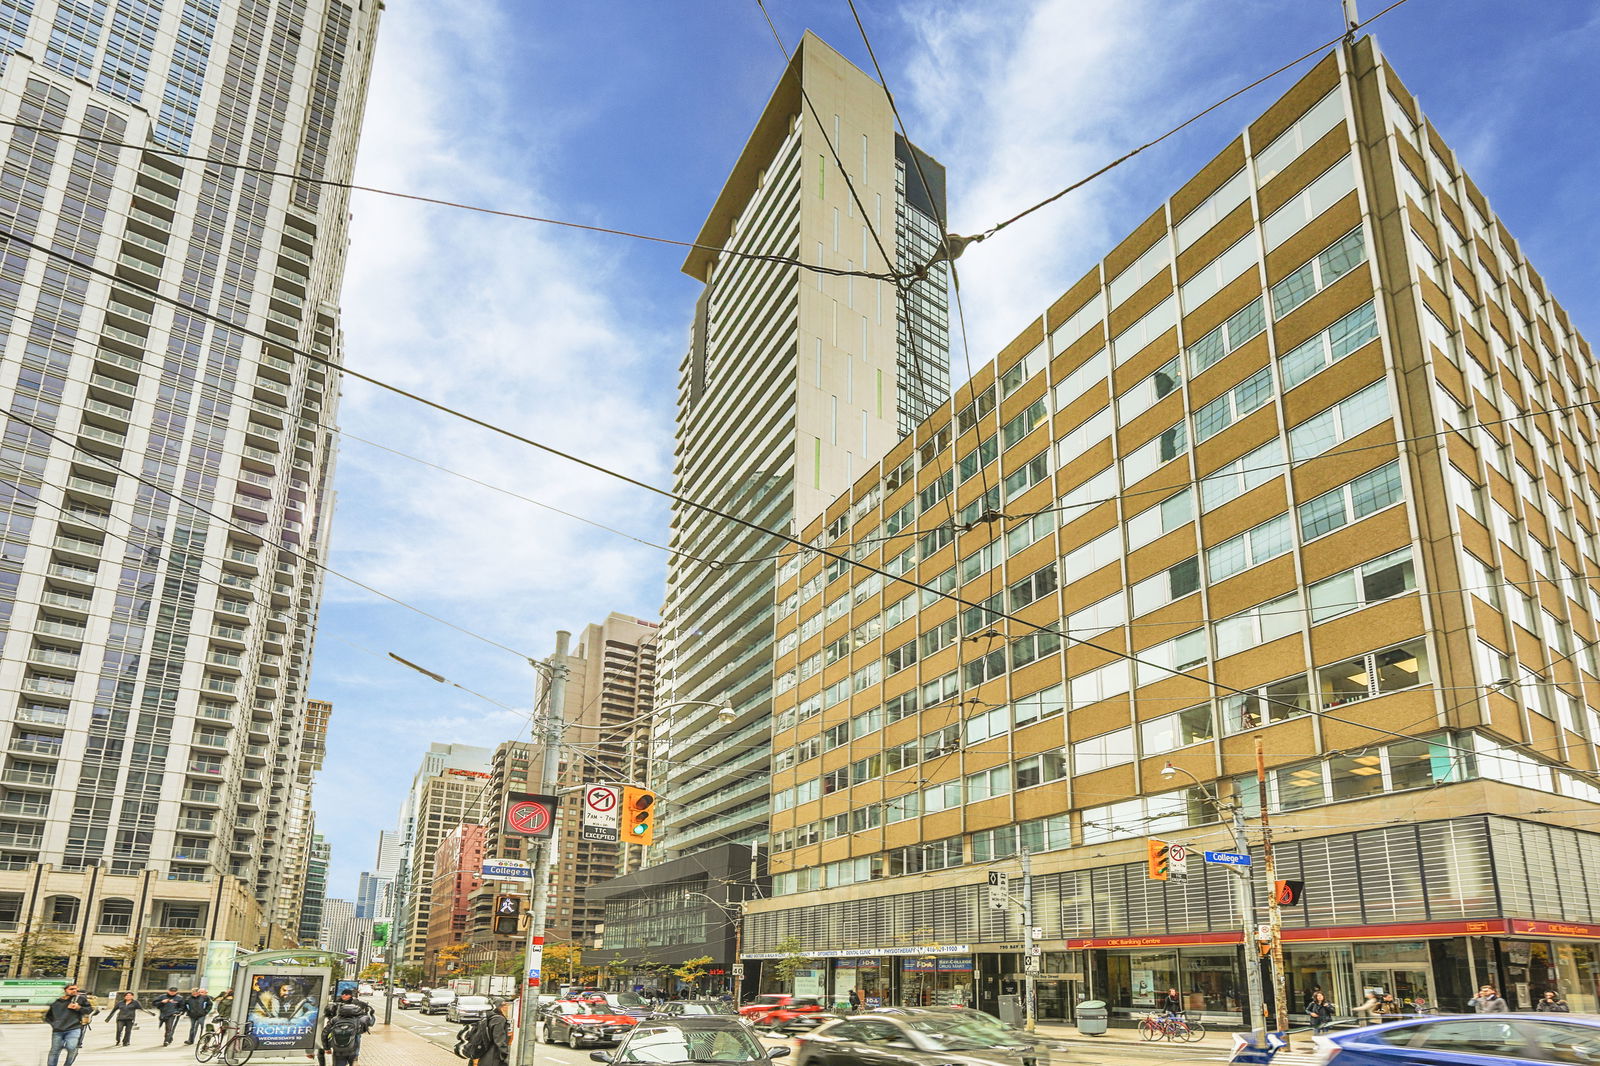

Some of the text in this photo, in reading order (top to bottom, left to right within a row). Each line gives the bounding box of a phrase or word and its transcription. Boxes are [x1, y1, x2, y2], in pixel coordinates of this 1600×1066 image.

[585, 832, 616, 840] EXCEPTED
[1212, 853, 1238, 863] College
[490, 866, 520, 876] College
[248, 1026, 312, 1035] FRONTIER
